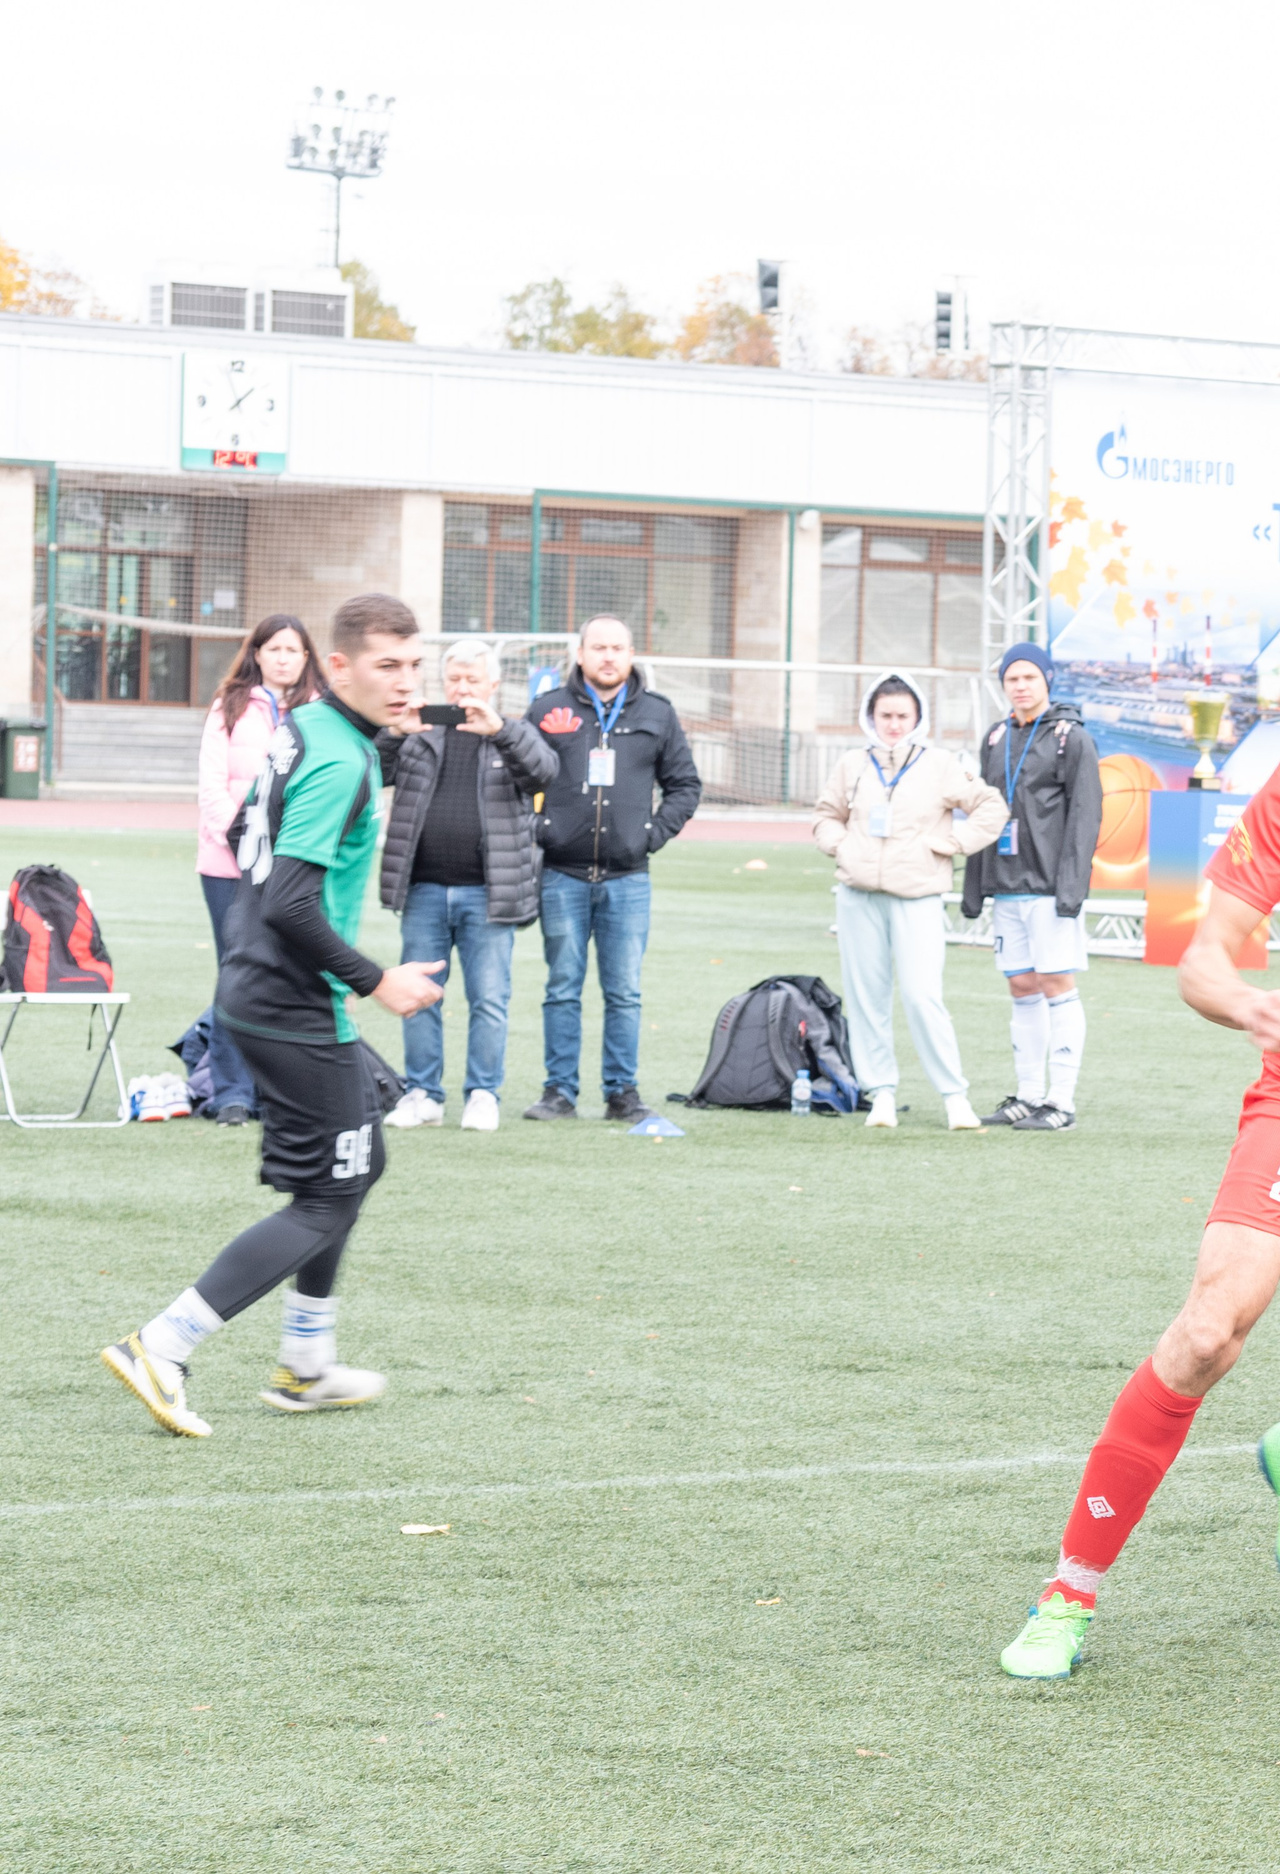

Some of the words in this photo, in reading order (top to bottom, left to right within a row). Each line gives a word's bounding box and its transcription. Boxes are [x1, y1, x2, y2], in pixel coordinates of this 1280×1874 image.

[230, 360, 245, 373] 12
[197, 394, 207, 407] 9
[266, 398, 275, 412] 3
[231, 433, 240, 446] 6
[1132, 456, 1235, 486] МОСЭНЕРГО
